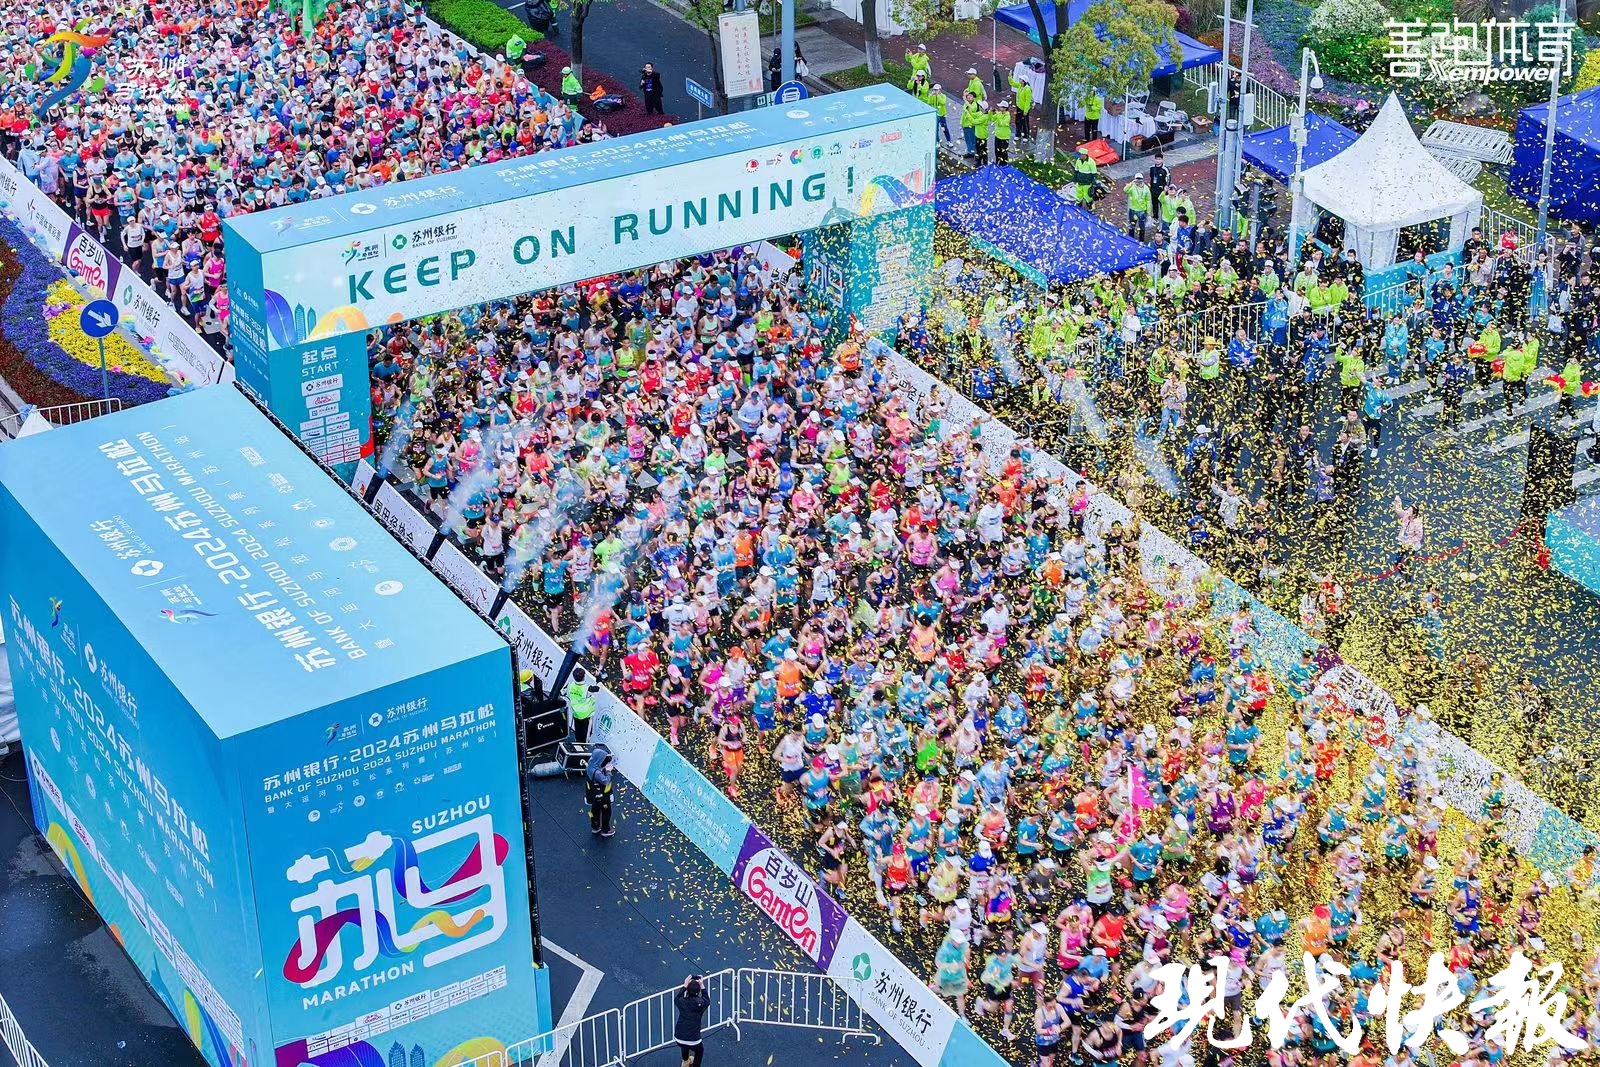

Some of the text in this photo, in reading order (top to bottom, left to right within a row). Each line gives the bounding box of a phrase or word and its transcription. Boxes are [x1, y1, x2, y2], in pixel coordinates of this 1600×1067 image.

[384, 185, 457, 207] 苏州银行
[79, 236, 104, 267] 百岁山
[411, 223, 457, 244] 苏州银行
[349, 248, 476, 304] KEEP
[513, 225, 576, 266] ON
[133, 294, 160, 328] 苏州银行
[301, 361, 339, 377] START
[302, 345, 337, 366] 起点
[90, 519, 144, 560] 苏州银行
[98, 438, 337, 672] 苏州银行·2024苏州马拉松
[136, 431, 368, 660] BANK OF SUZHOU 2024 SUZHOU MARATHON
[514, 629, 553, 679] 苏州银行
[100, 659, 138, 718] 苏州银行
[386, 697, 428, 719] 苏州银行
[14, 629, 34, 664] BANK
[35, 659, 47, 679] OF
[50, 677, 85, 730] SUZHOU
[113, 759, 153, 816] SUZHOU
[156, 811, 214, 888] MARATHON
[263, 703, 495, 792] 苏州银行·2024苏州马拉松
[264, 719, 496, 803] BANK OF SUZHOU 2024 SUZHOU MARATHON
[411, 795, 491, 834] SUZHOU
[764, 850, 814, 909] 百岁山
[747, 866, 817, 953] Ganten
[302, 960, 415, 1011] MARATHON
[874, 969, 932, 1036] 苏州银行
[869, 991, 926, 1048] BANK OF SUZHOU
